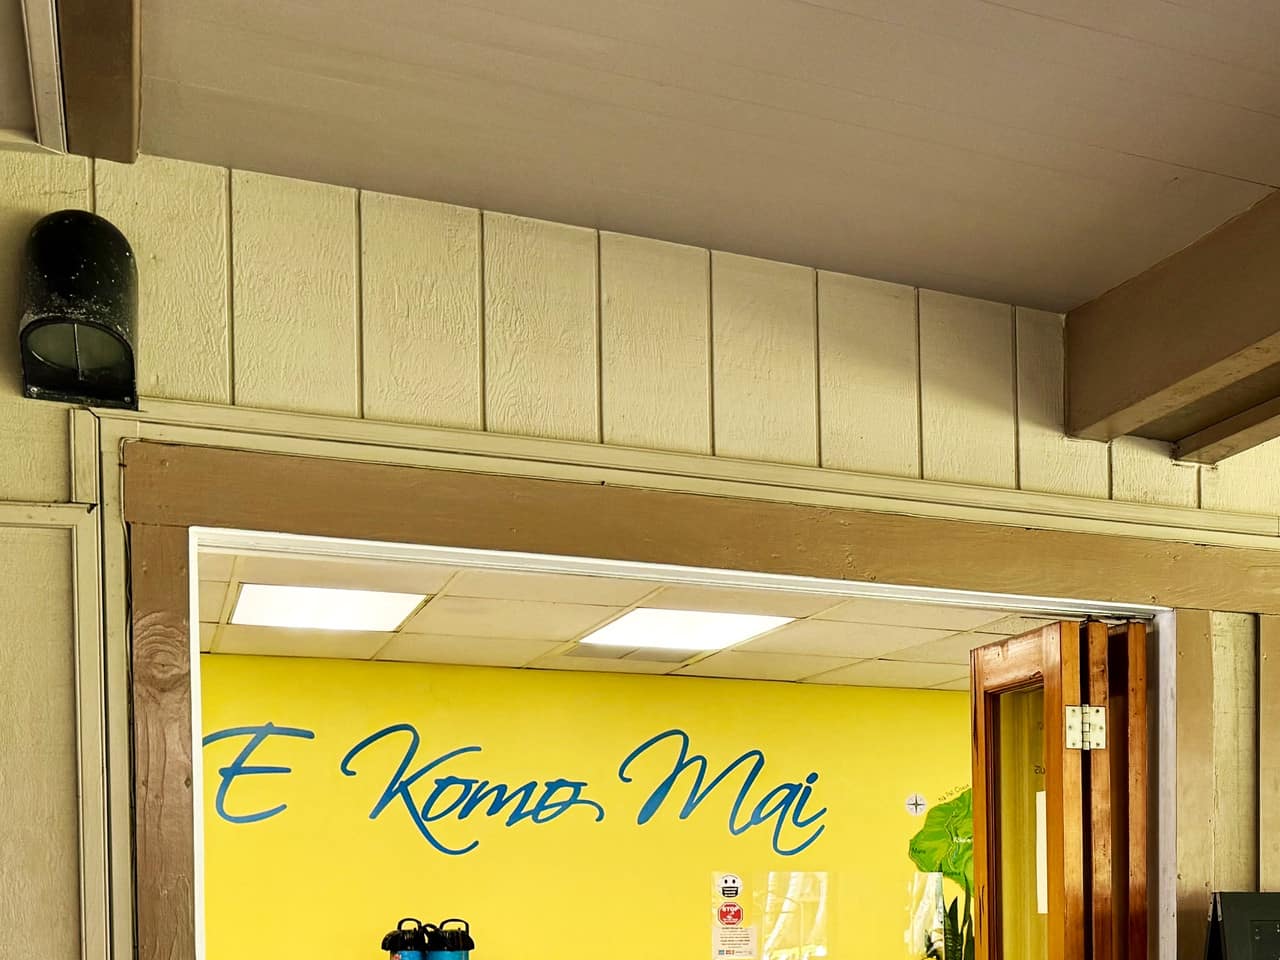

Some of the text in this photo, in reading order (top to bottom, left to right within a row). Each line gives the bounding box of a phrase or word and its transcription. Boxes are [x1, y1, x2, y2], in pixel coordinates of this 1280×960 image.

[202, 722, 828, 856] E Komo Mai
